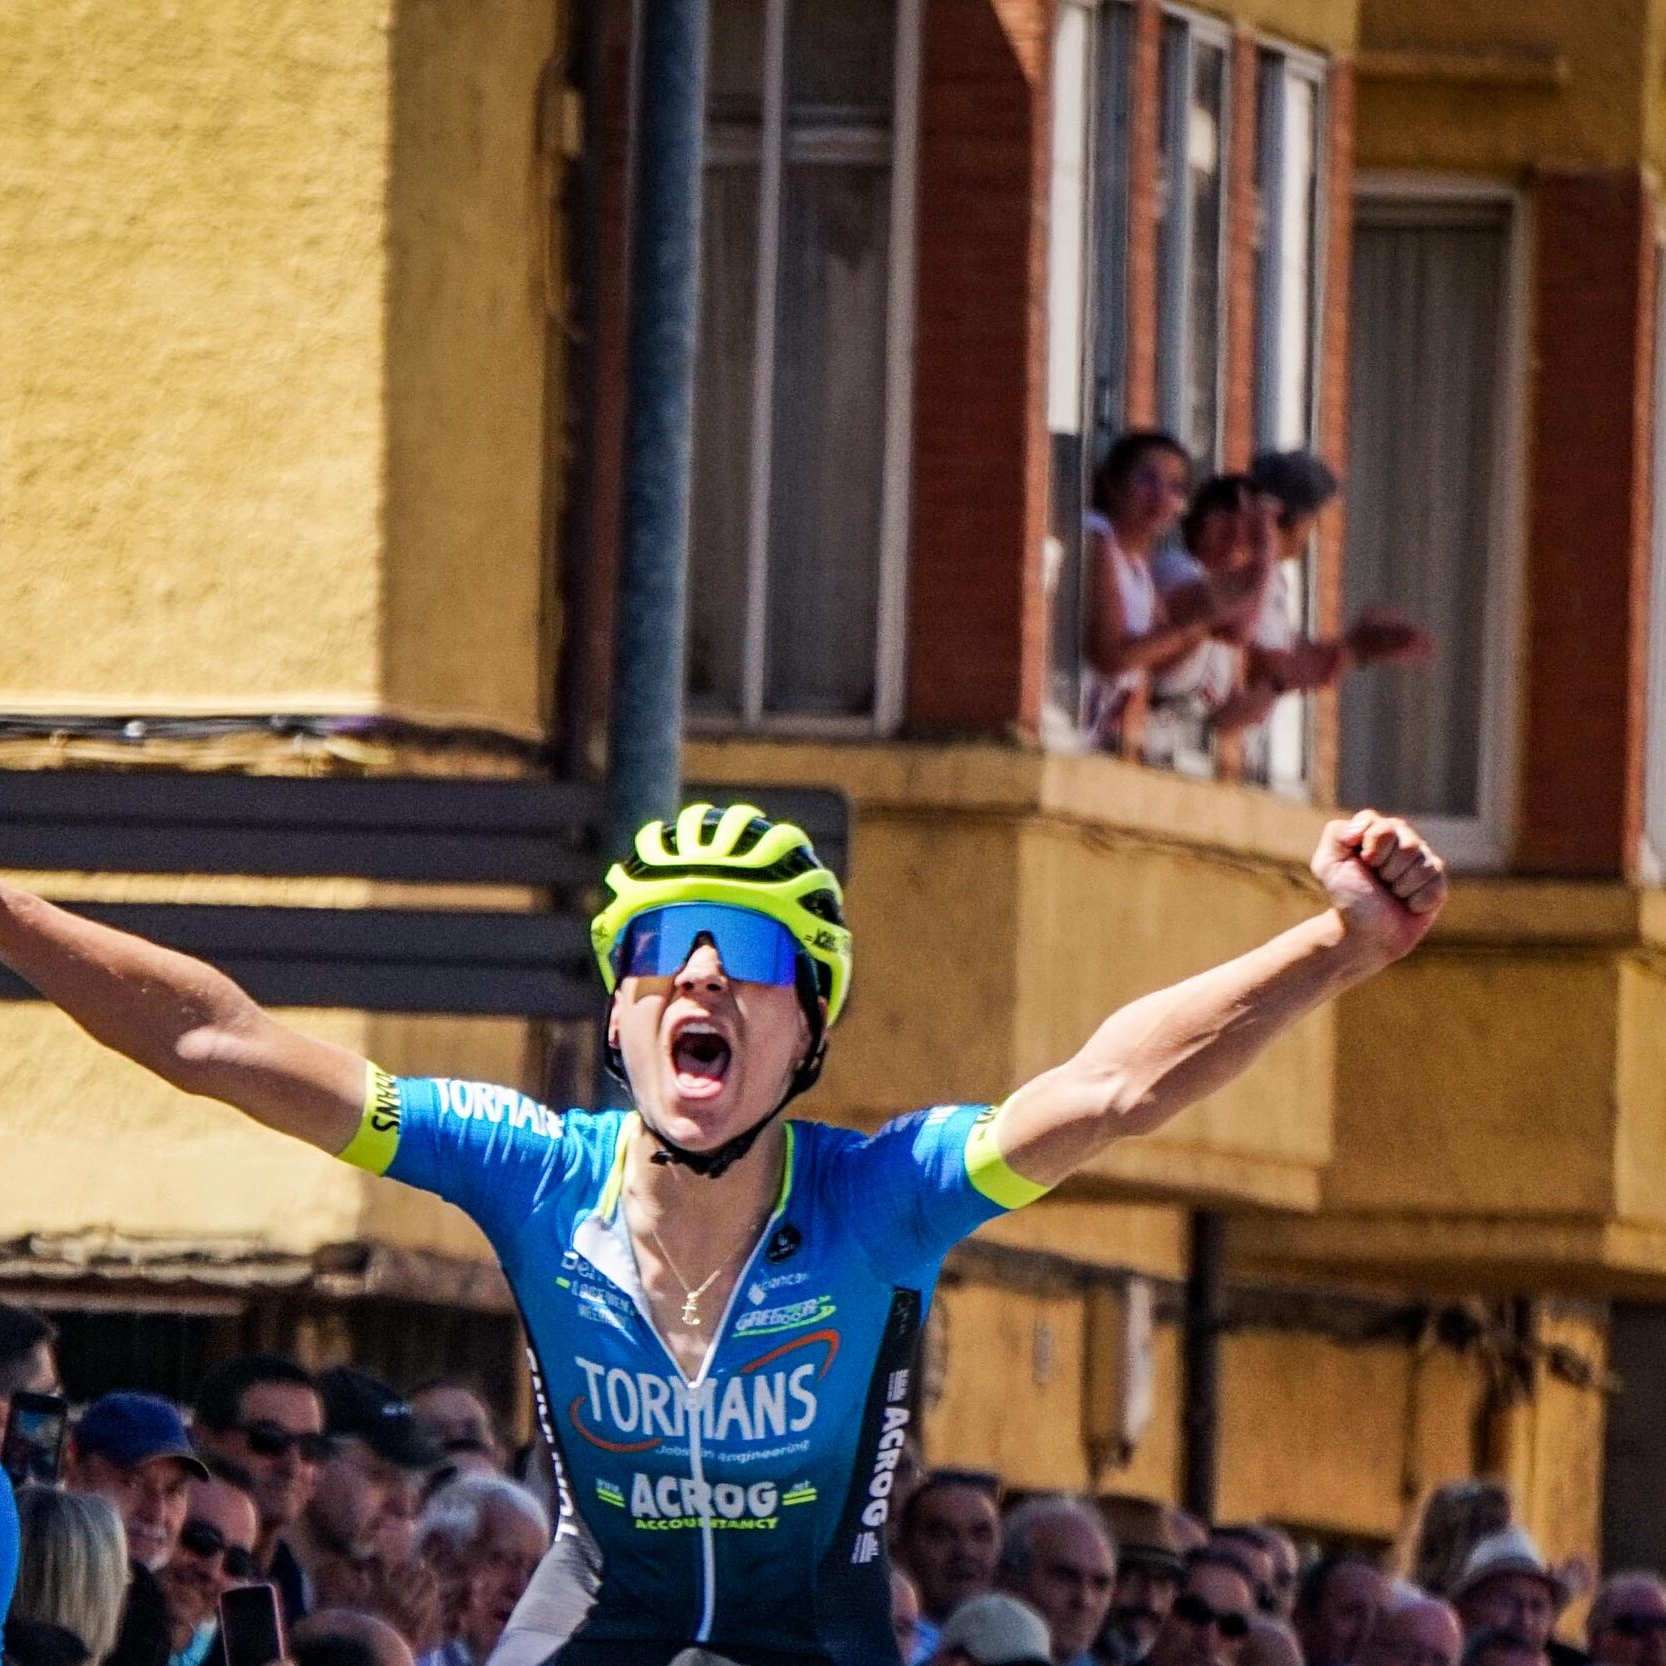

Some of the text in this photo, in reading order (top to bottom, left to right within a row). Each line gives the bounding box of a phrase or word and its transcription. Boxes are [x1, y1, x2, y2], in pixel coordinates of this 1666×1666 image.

[573, 1355, 819, 1442] TORMANS
[630, 1473, 780, 1520] ACROG
[861, 1406, 910, 1527] ACROG
